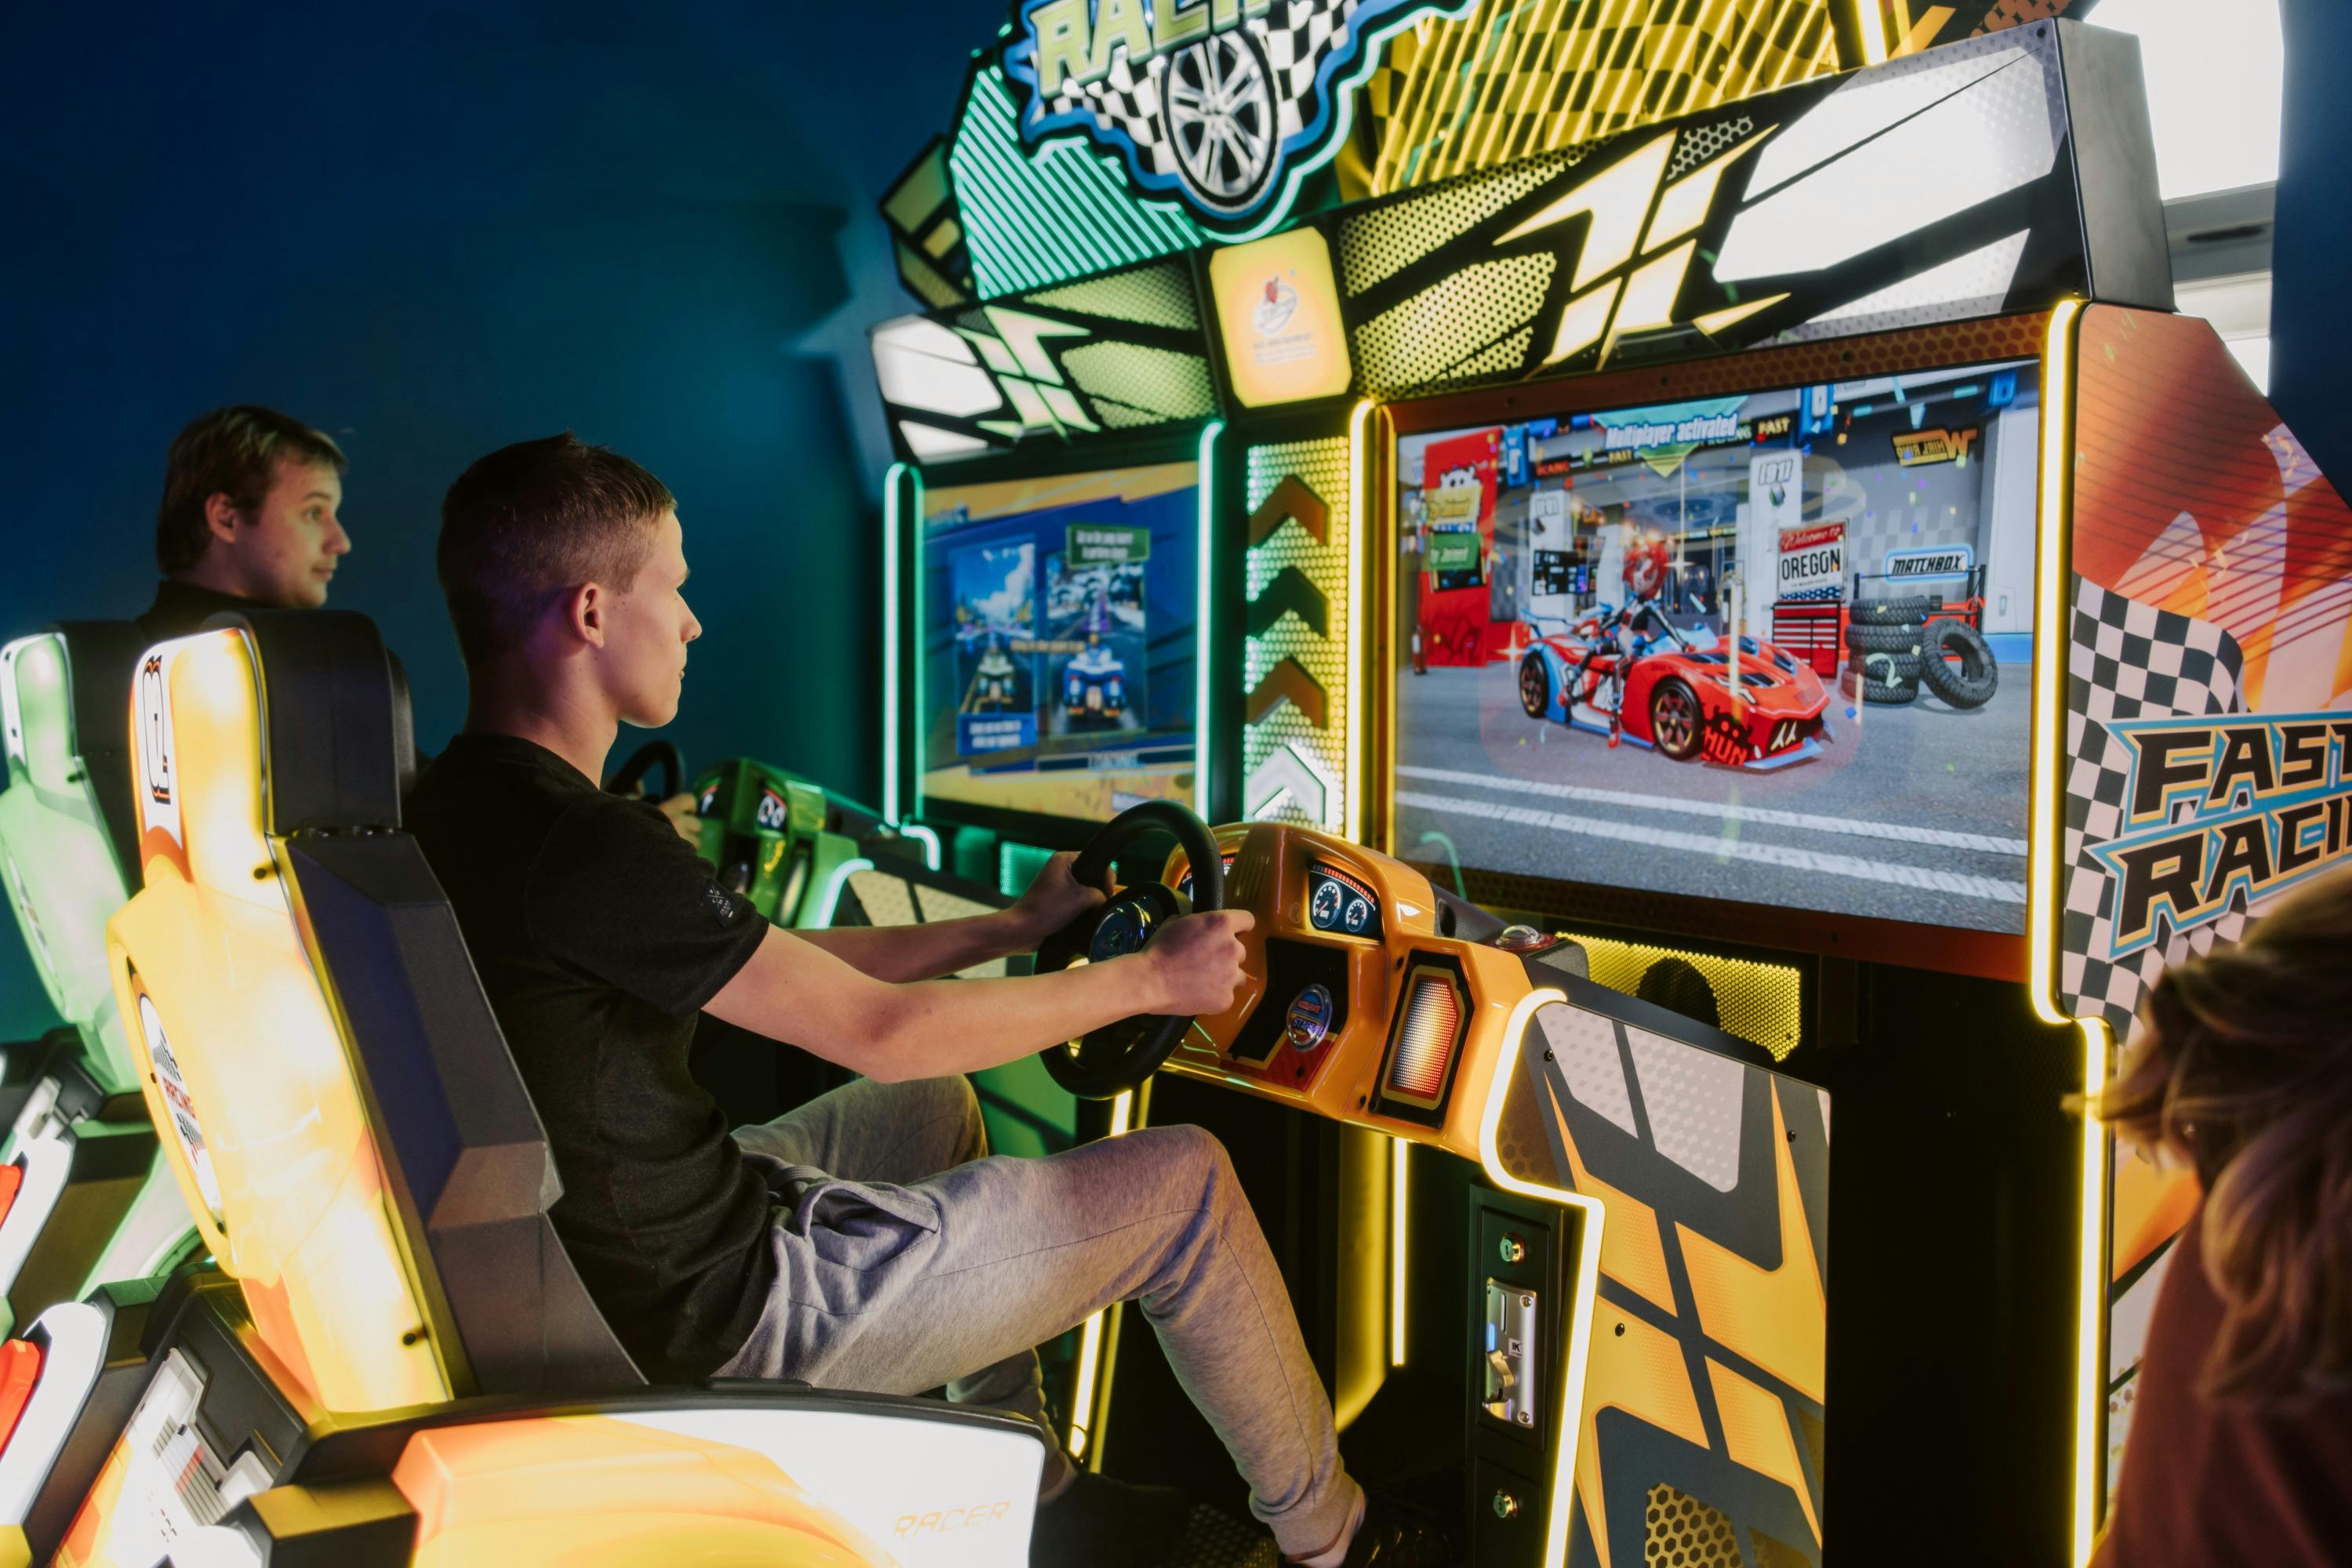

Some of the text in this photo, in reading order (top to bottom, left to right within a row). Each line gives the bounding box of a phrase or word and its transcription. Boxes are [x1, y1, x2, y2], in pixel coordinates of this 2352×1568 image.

[1605, 423, 1676, 450] Multiplayer
[1676, 412, 1739, 442] activated
[1757, 416, 1791, 437] FAST
[1781, 547, 1841, 580] OREGON
[1892, 554, 1965, 575] MATCHBOX
[2109, 790, 2352, 946] RACI
[894, 1501, 1011, 1537] RACER
